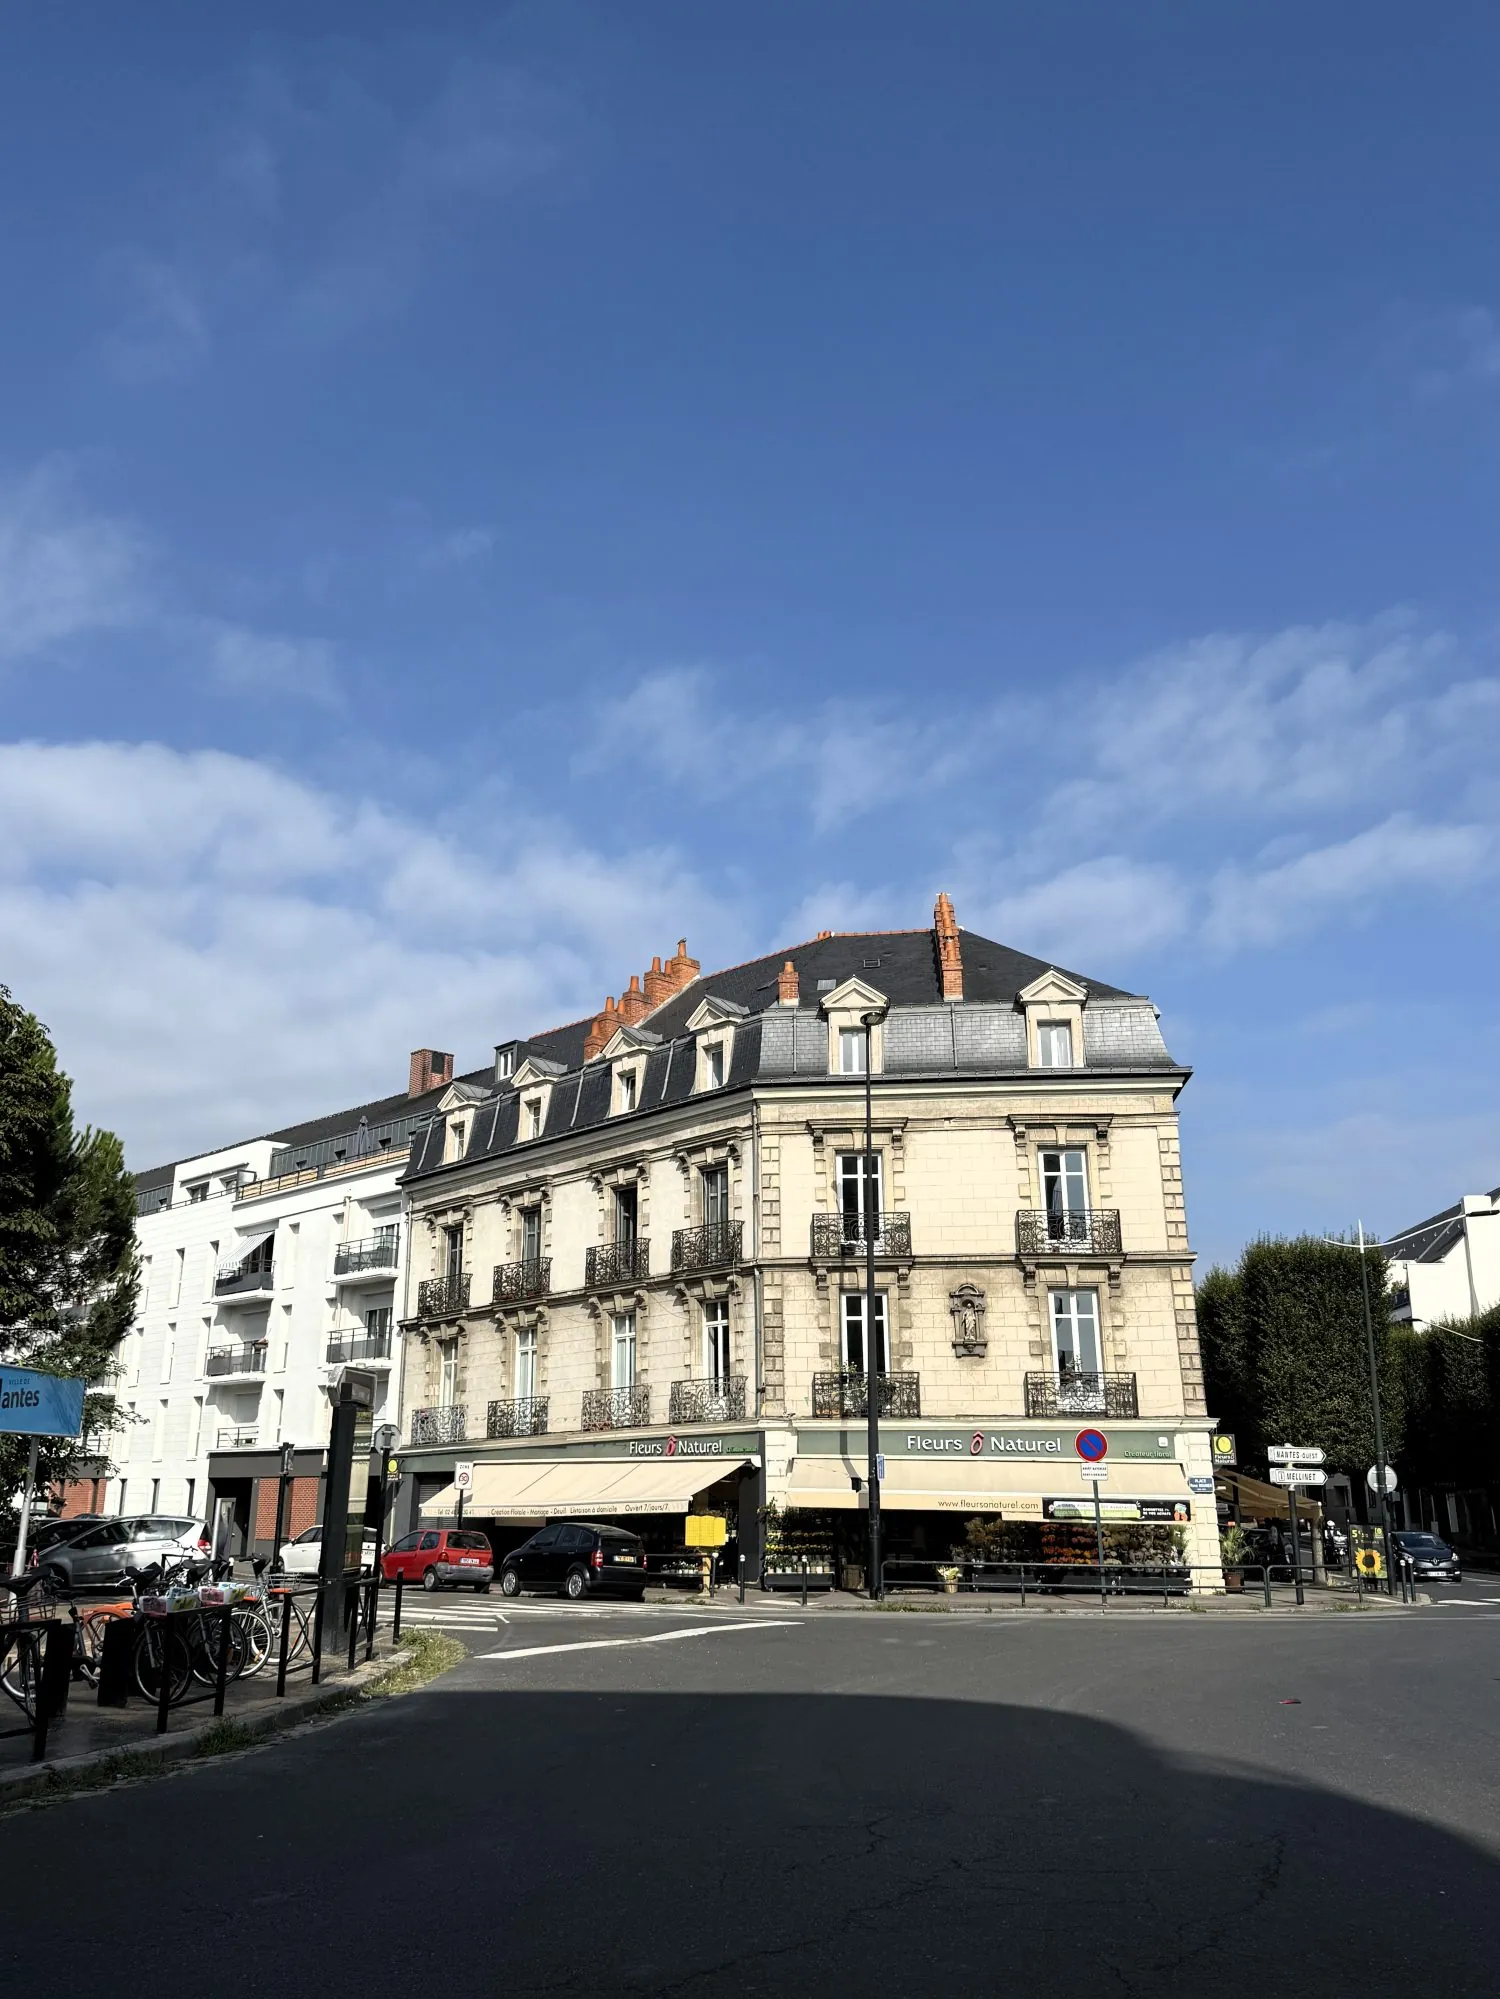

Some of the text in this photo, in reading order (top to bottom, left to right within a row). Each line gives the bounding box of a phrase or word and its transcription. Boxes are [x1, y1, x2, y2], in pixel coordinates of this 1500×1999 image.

[629, 1441, 662, 1454] Fleurs
[678, 1439, 722, 1454] Naturel
[907, 1435, 963, 1450] Fleurs
[990, 1436, 1061, 1452] Naturel
[1276, 1451, 1300, 1459] NANTES
[1286, 1472, 1316, 1481] MELLINET
[624, 1504, 643, 1512] Ouvert
